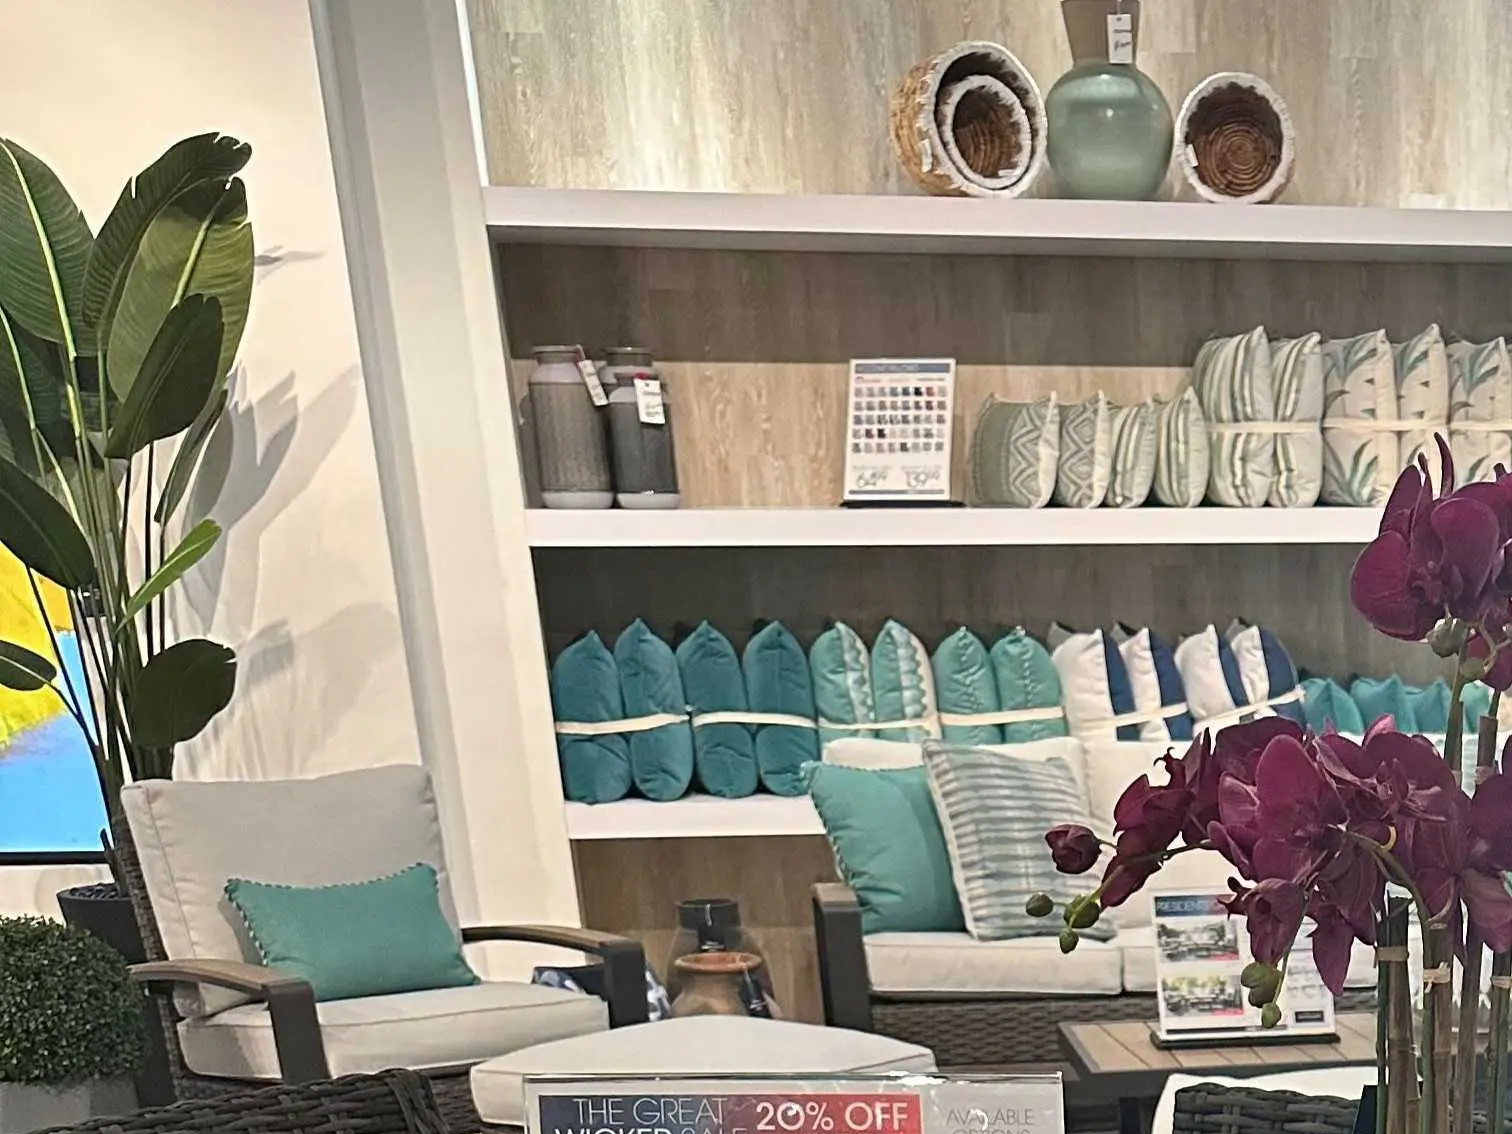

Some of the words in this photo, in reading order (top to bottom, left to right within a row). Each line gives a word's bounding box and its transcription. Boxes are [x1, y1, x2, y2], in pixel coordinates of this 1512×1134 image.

[573, 1098, 624, 1125] THE
[633, 1098, 727, 1125] GREAT
[756, 1102, 834, 1131] 20%
[845, 1102, 908, 1131] OFF
[946, 1108, 1035, 1126] AVAILABLE
